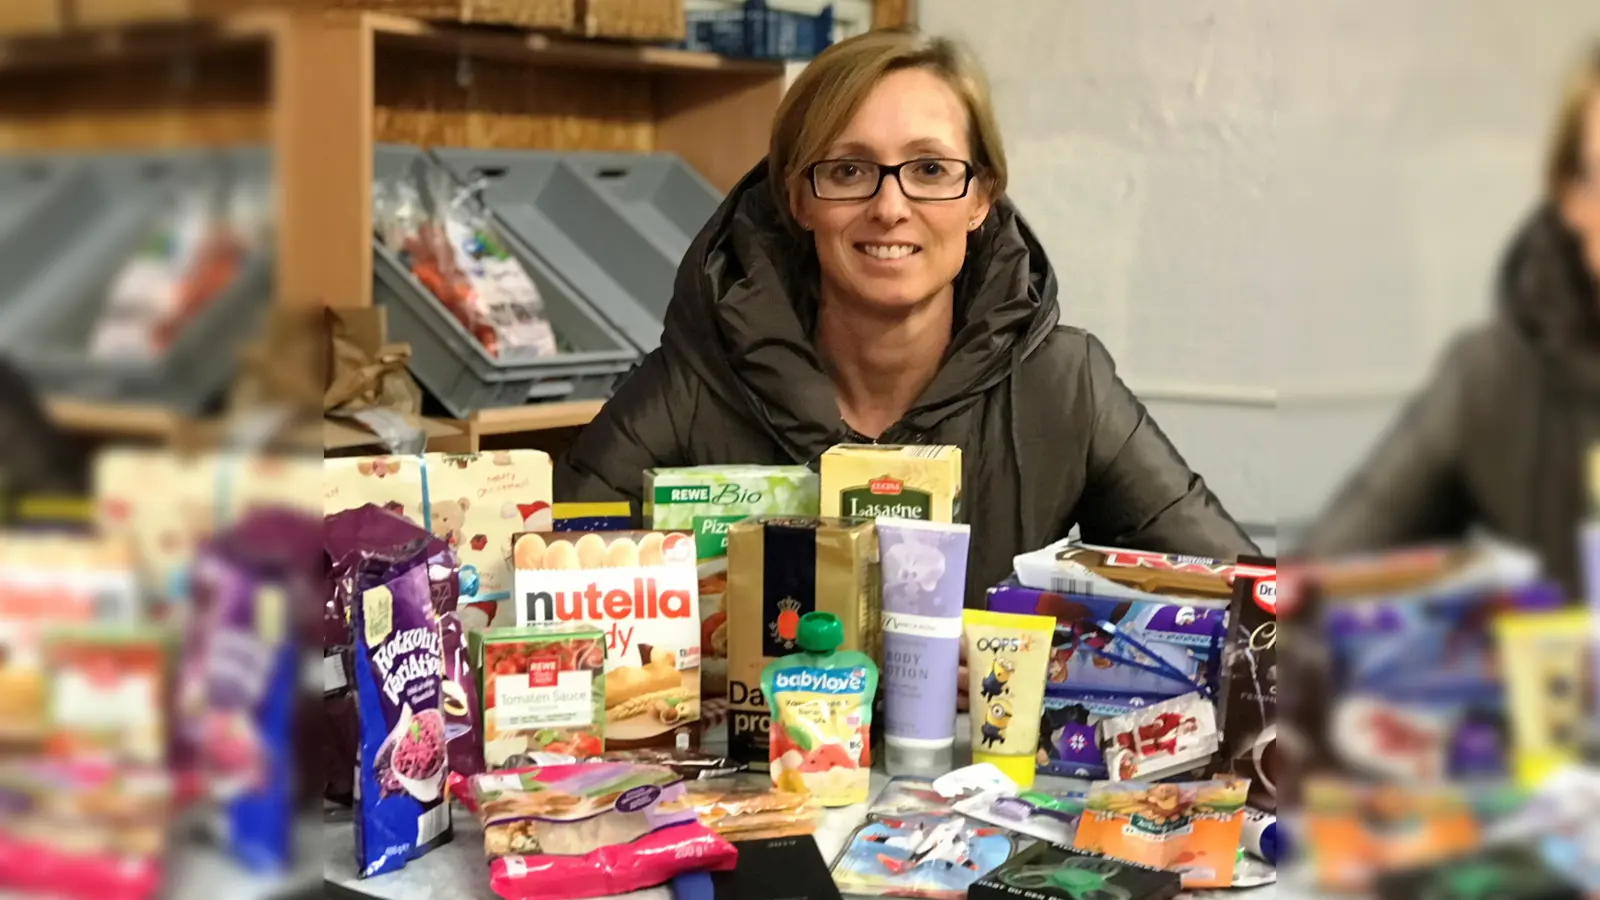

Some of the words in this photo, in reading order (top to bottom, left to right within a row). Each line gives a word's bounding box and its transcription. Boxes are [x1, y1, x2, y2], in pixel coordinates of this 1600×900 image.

[671, 489, 709, 502] REWE
[711, 483, 762, 506] Bio
[850, 498, 922, 519] Lasagne
[526, 577, 691, 622] nutella
[776, 670, 862, 691] babylove
[883, 664, 929, 680] OTION
[501, 692, 550, 706] Tomaten
[552, 689, 587, 703] Sauce
